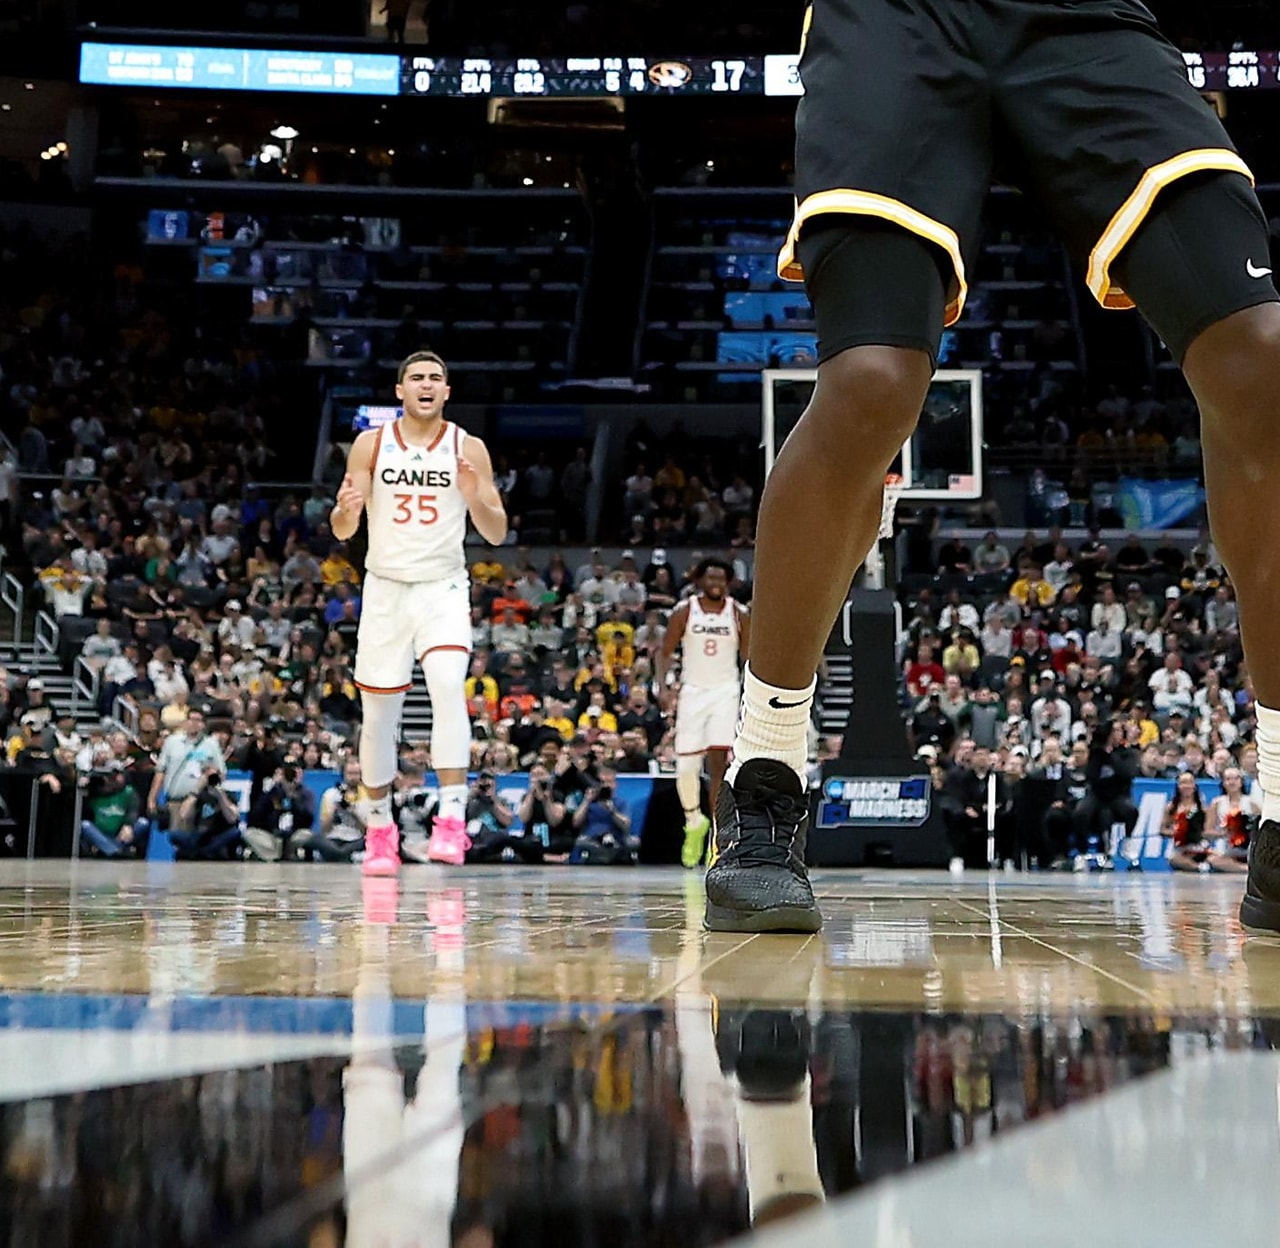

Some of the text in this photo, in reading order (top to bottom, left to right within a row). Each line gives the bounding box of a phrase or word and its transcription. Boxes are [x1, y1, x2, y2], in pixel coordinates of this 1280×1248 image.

[415, 71, 430, 92] 0
[606, 71, 620, 92] 5
[711, 60, 747, 92] 17
[381, 468, 451, 488] CANES
[392, 494, 438, 525] 35
[704, 639, 717, 656] 8
